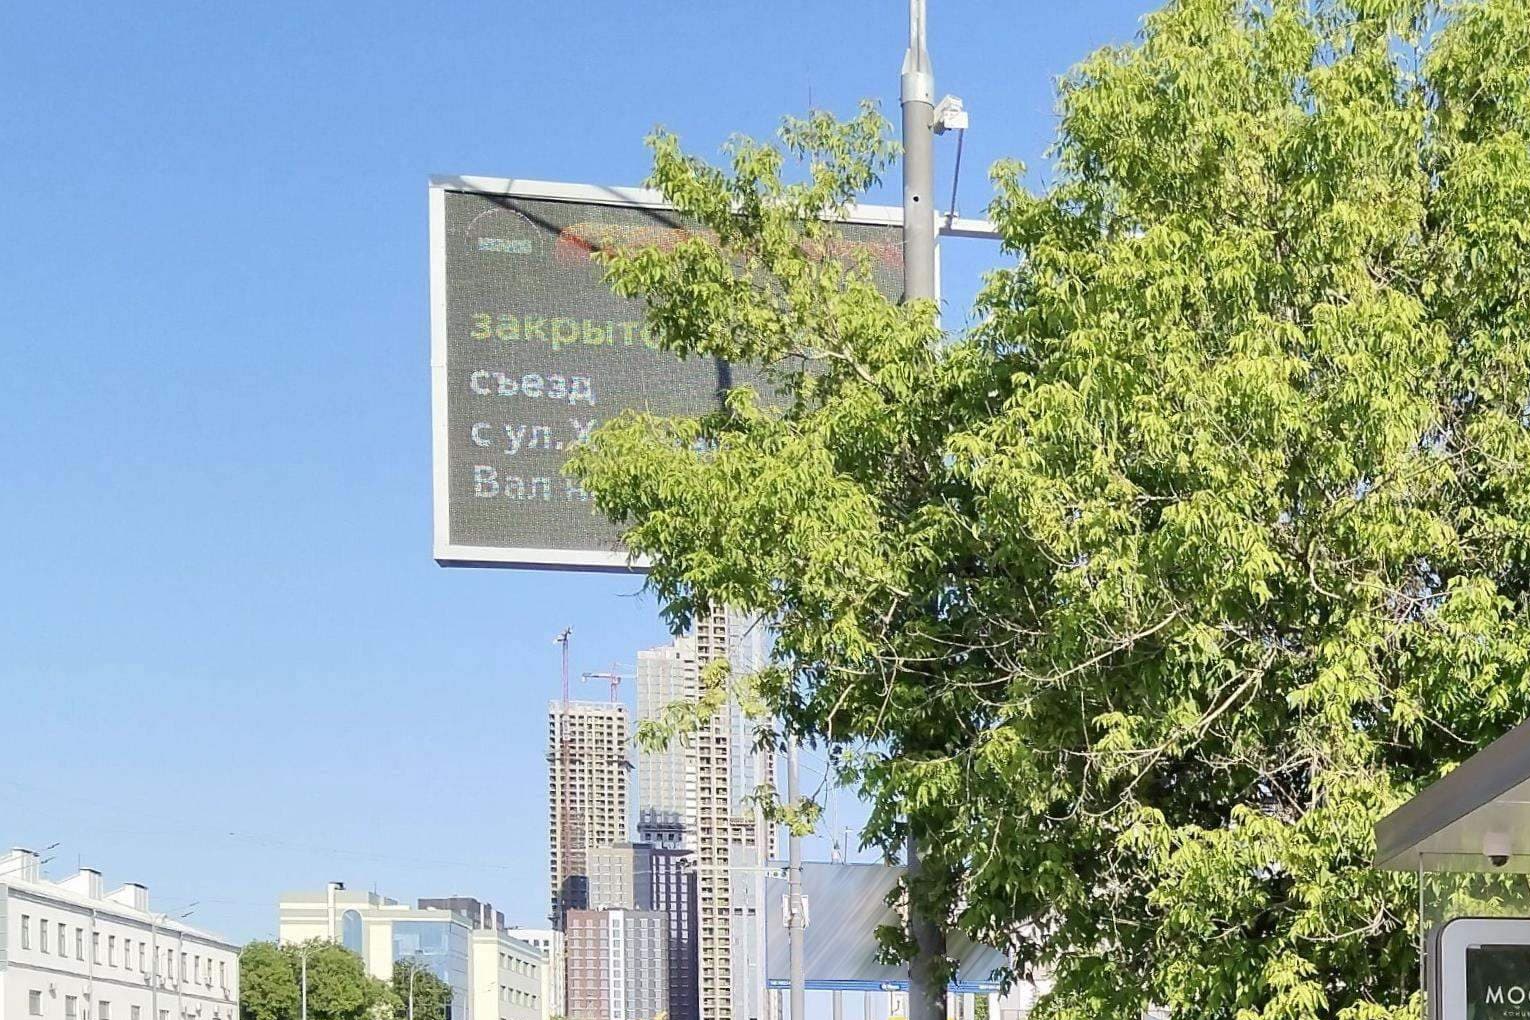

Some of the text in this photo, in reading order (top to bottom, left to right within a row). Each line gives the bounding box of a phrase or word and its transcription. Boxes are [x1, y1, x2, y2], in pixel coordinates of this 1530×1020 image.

[470, 369, 597, 406] съезд
[471, 421, 493, 448] с
[474, 464, 552, 500] Вал
